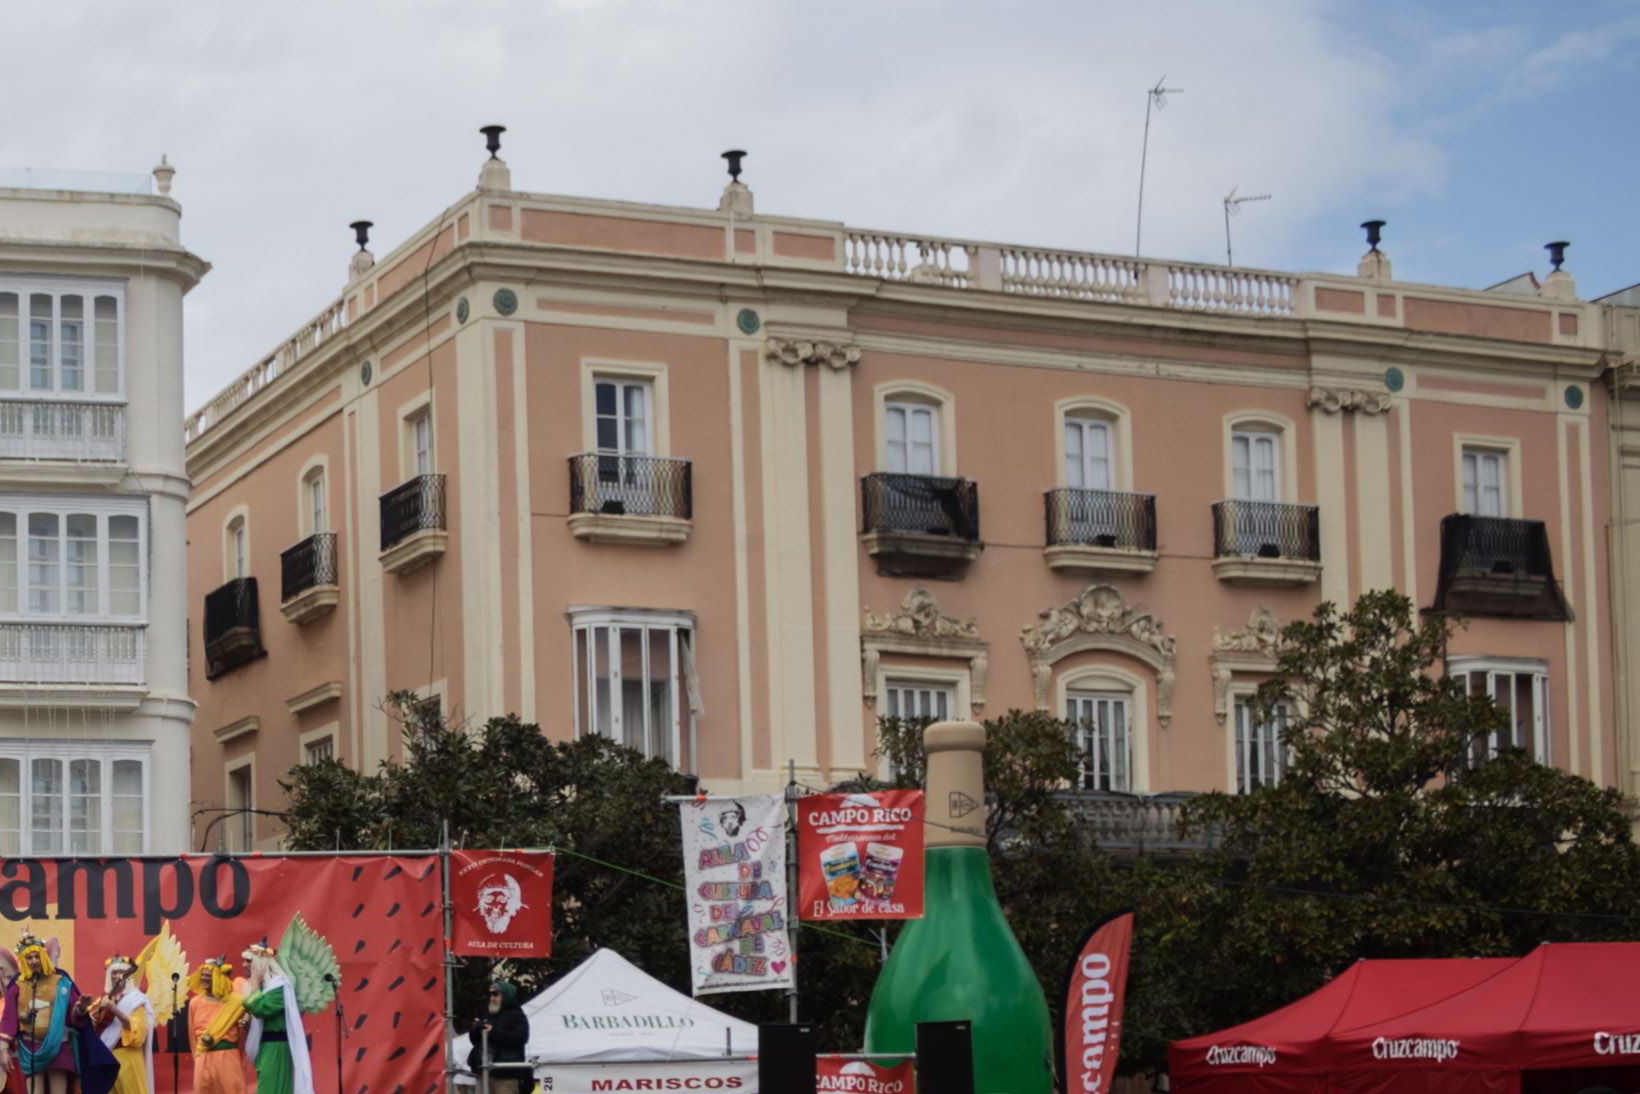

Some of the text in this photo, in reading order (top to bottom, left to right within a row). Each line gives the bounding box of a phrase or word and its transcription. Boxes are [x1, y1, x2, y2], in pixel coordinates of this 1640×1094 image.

[808, 807, 912, 827] CAMPO RICO
[698, 842, 750, 870] AULA
[738, 861, 762, 879] DE
[698, 880, 772, 901] CULTURA
[710, 903, 740, 922] DEL
[813, 900, 905, 917] El Sabor de casa
[693, 911, 784, 947] CARNAVAL
[740, 935, 764, 955] DE
[712, 948, 767, 976] CÁDIZ
[561, 1013, 695, 1029] BARBADILLO
[1206, 1045, 1277, 1067] Cruzcampo
[1372, 1037, 1460, 1062] Cruzcampo
[544, 1076, 554, 1092] 28
[591, 1076, 743, 1092] MARISCOS
[868, 1078, 903, 1094] RICO
